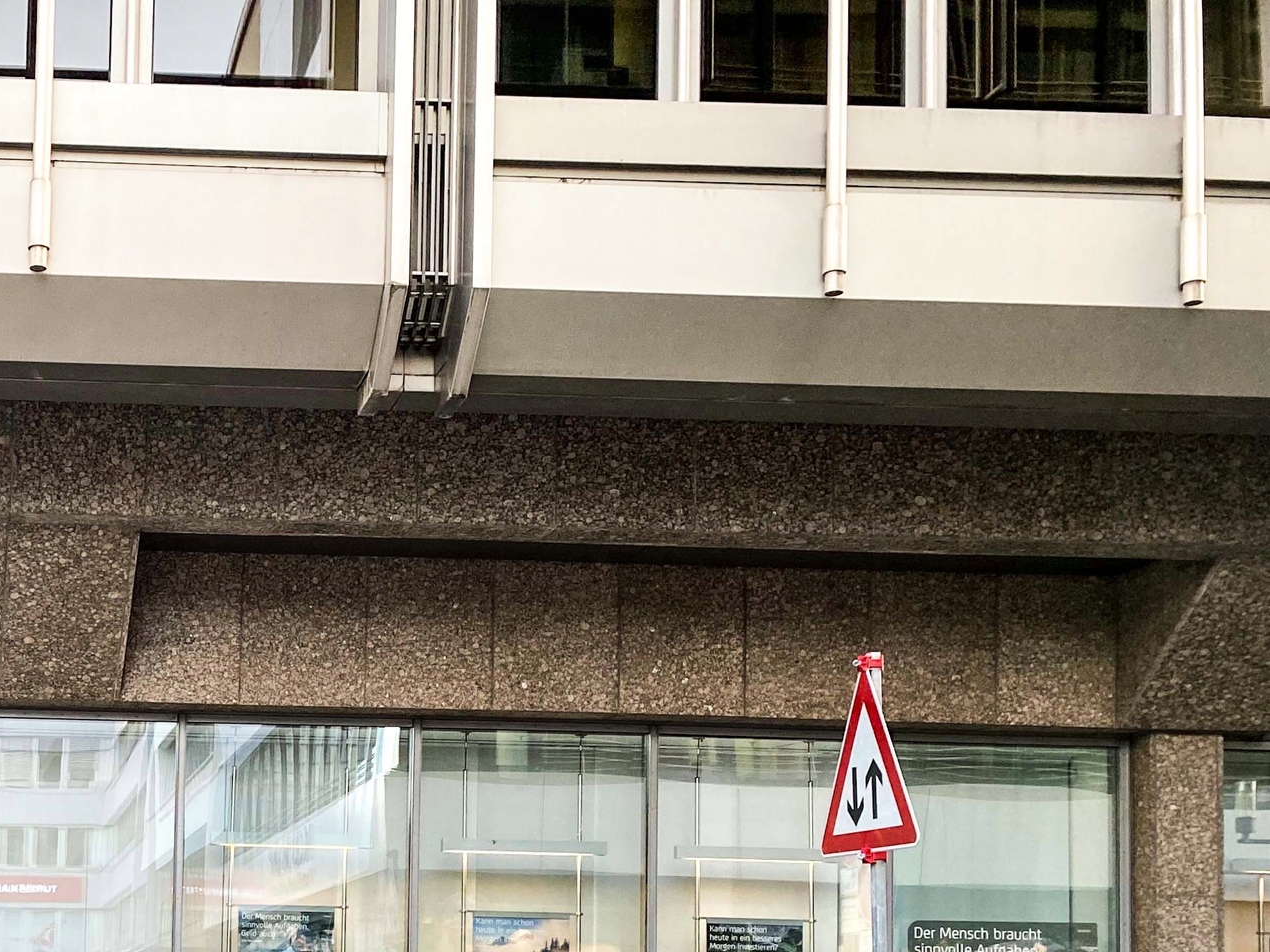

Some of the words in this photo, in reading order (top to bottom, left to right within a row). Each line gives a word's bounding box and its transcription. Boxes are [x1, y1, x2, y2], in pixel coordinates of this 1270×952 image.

[747, 926, 768, 934] schon
[914, 927, 936, 939] Der
[939, 926, 989, 940] Mensch
[993, 928, 1043, 940] braucht
[709, 933, 729, 941] heute
[752, 935, 782, 943] besseres
[709, 942, 736, 952] Morgen
